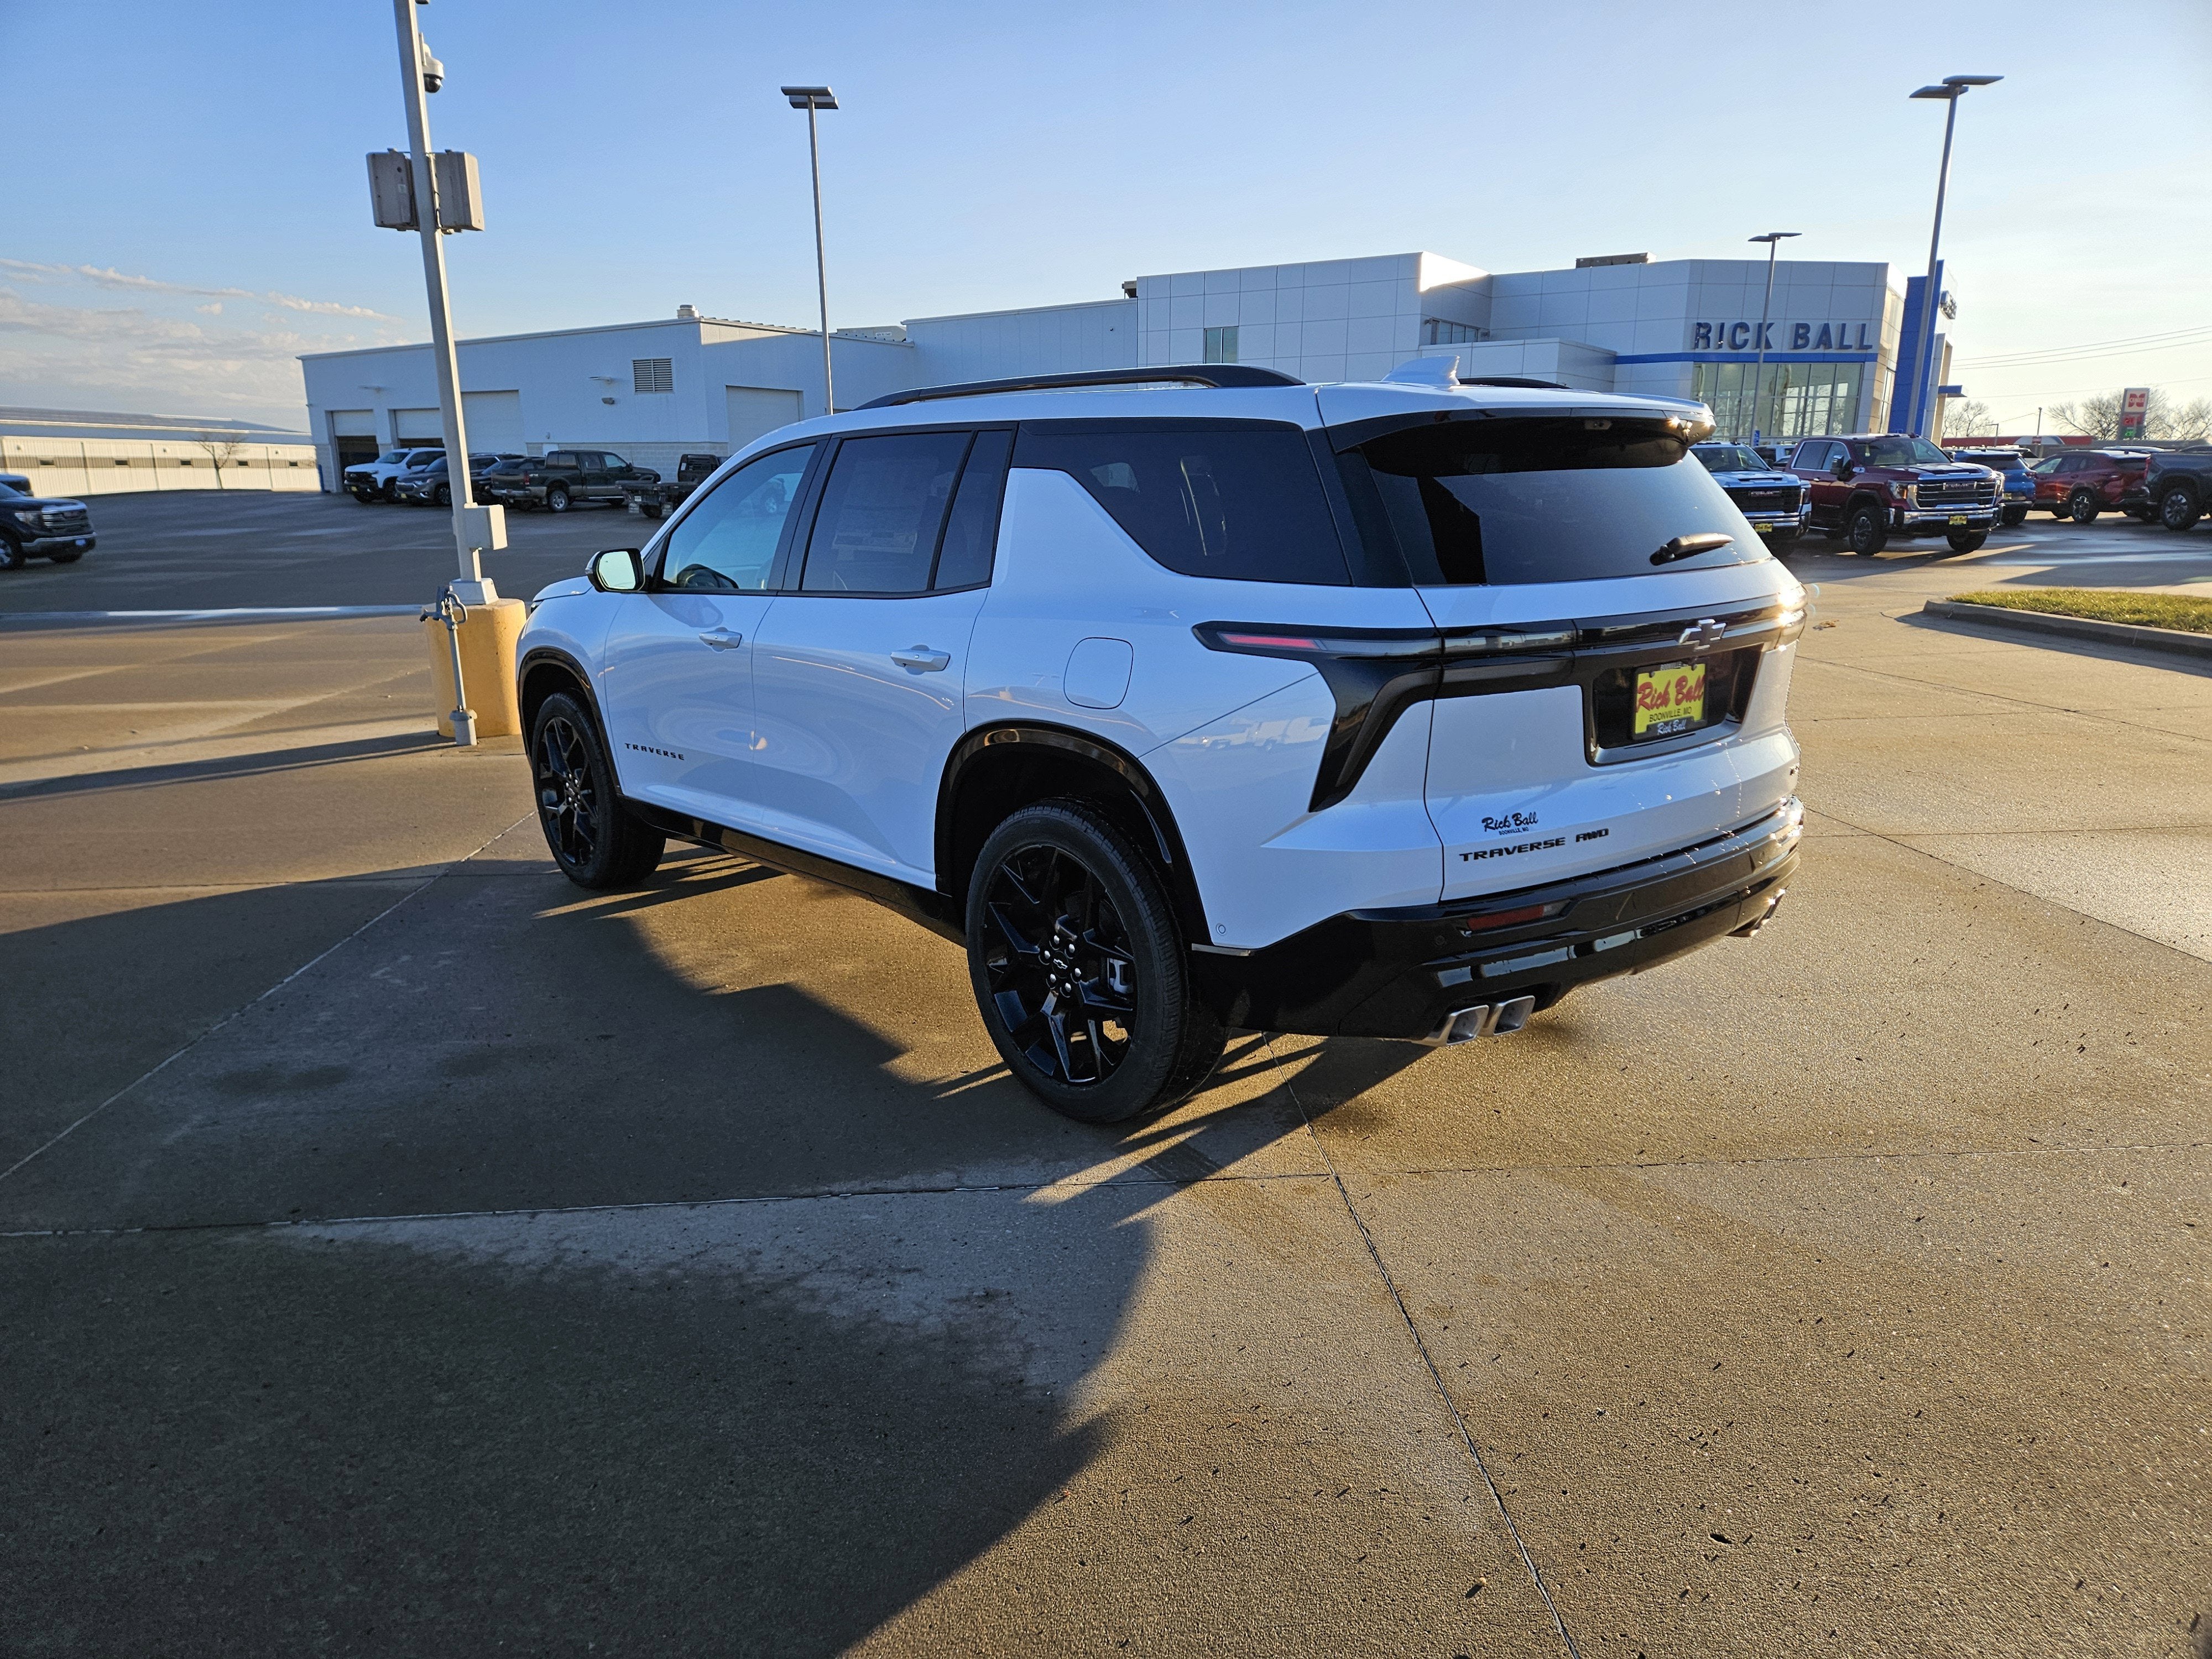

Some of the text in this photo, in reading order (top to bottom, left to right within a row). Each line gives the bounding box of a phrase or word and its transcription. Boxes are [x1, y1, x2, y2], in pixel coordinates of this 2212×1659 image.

[1694, 322, 1873, 350] RICK BALL
[1636, 674, 1705, 712] Rick Ball
[1683, 706, 1692, 715] MO
[624, 743, 685, 760] TRAVERSE
[1481, 811, 1539, 832] Rick Ball
[1459, 828, 1610, 862] TRAVERSE AWD
